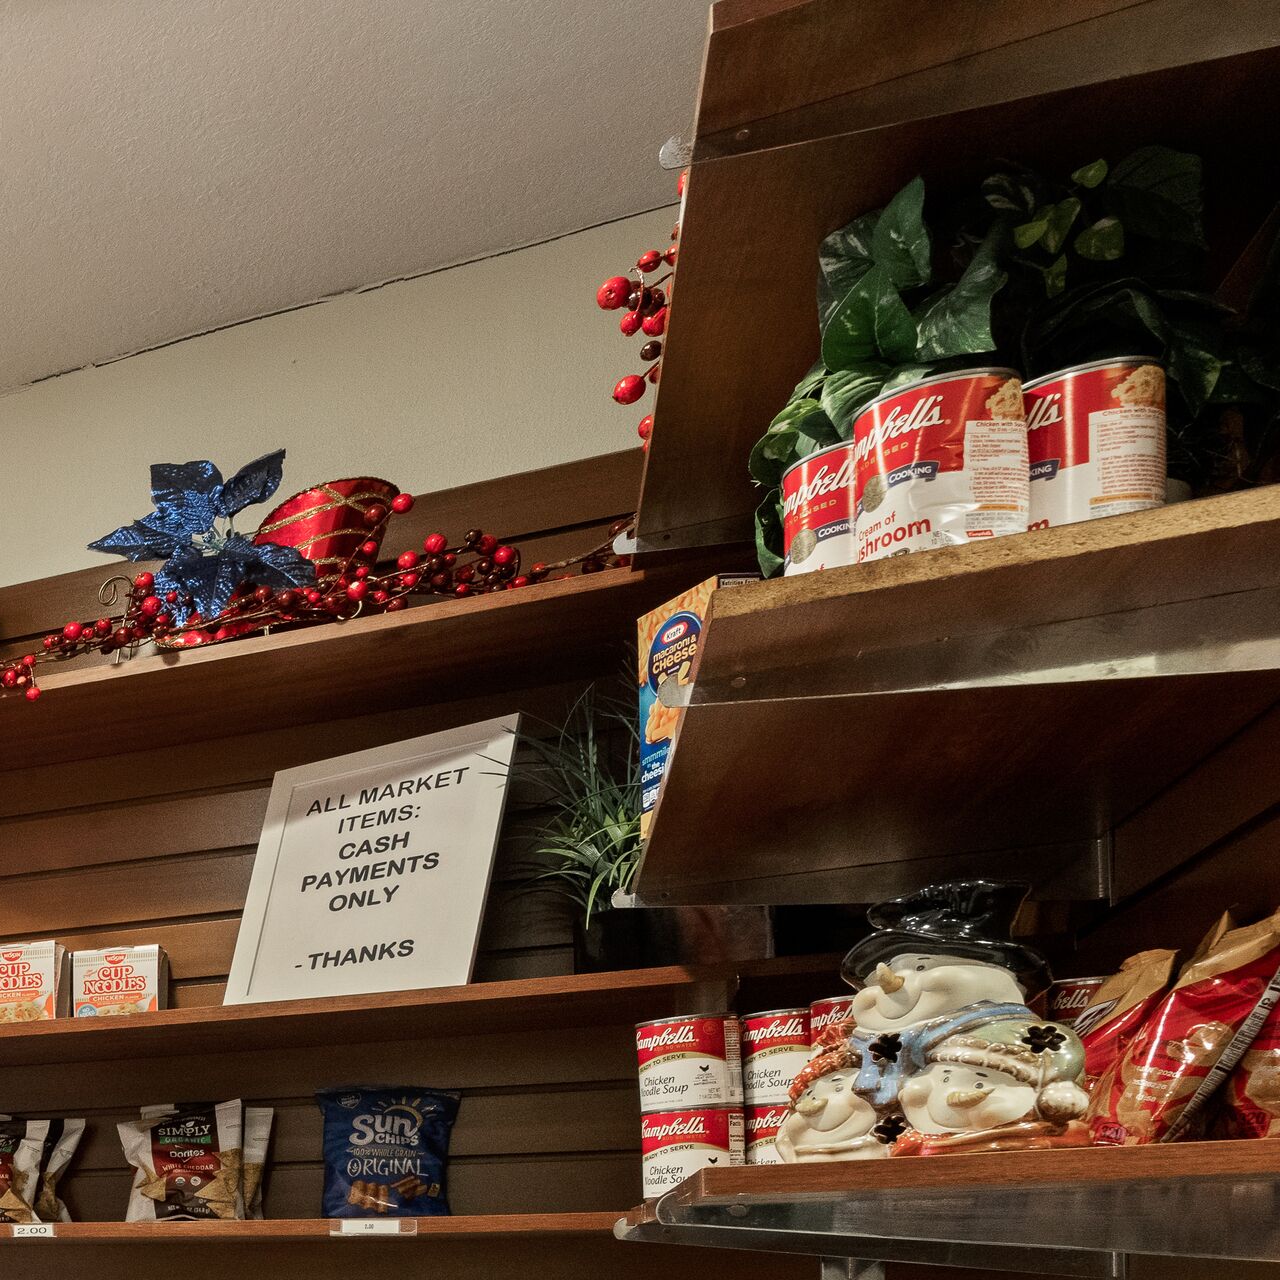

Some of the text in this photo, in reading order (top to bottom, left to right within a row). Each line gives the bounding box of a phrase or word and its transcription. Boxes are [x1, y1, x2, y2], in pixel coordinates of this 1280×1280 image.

[888, 466, 933, 484] COOKING
[858, 511, 897, 542] Cream of
[653, 636, 690, 662] macaroni
[306, 766, 470, 817] ALL MARKET
[337, 803, 422, 834] ITEMS:
[338, 831, 411, 860] CASH
[300, 852, 440, 892] PAYMENTS
[328, 884, 400, 912] ONLY
[307, 938, 415, 971] THANKS
[98, 965, 134, 980] CUP
[83, 975, 147, 995] NOODLES
[643, 1075, 675, 1088] Chicken
[747, 1069, 781, 1081] Chicken
[157, 1123, 211, 1137] SIMPLY
[374, 1132, 420, 1147] CHIPS
[169, 1149, 206, 1159] Doritos
[372, 1148, 395, 1157] WHOLE
[395, 1148, 417, 1157] GRAIN
[347, 1157, 429, 1178] ORIGINAL
[649, 1164, 684, 1176] Chicken
[17, 1227, 48, 1235] 2.00
